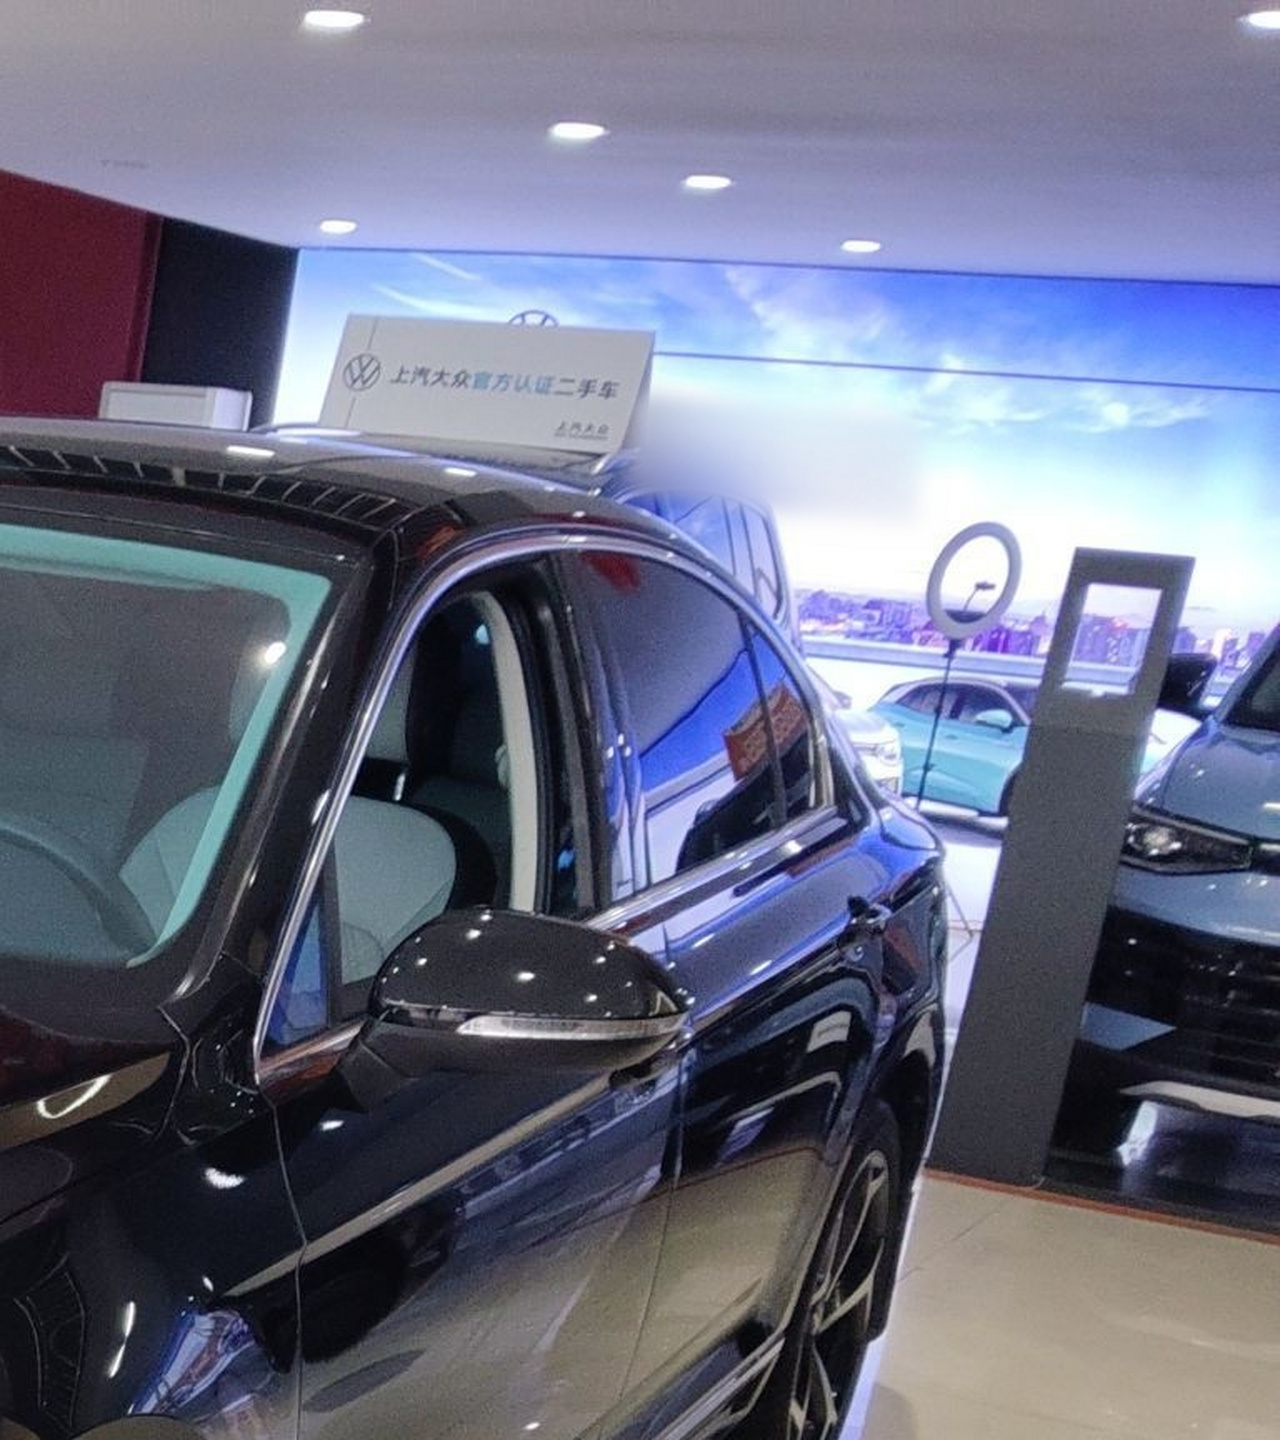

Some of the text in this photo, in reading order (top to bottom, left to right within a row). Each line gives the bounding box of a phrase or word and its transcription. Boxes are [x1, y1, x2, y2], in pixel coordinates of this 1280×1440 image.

[390, 365, 621, 400] 上汽大众官方认证二手车
